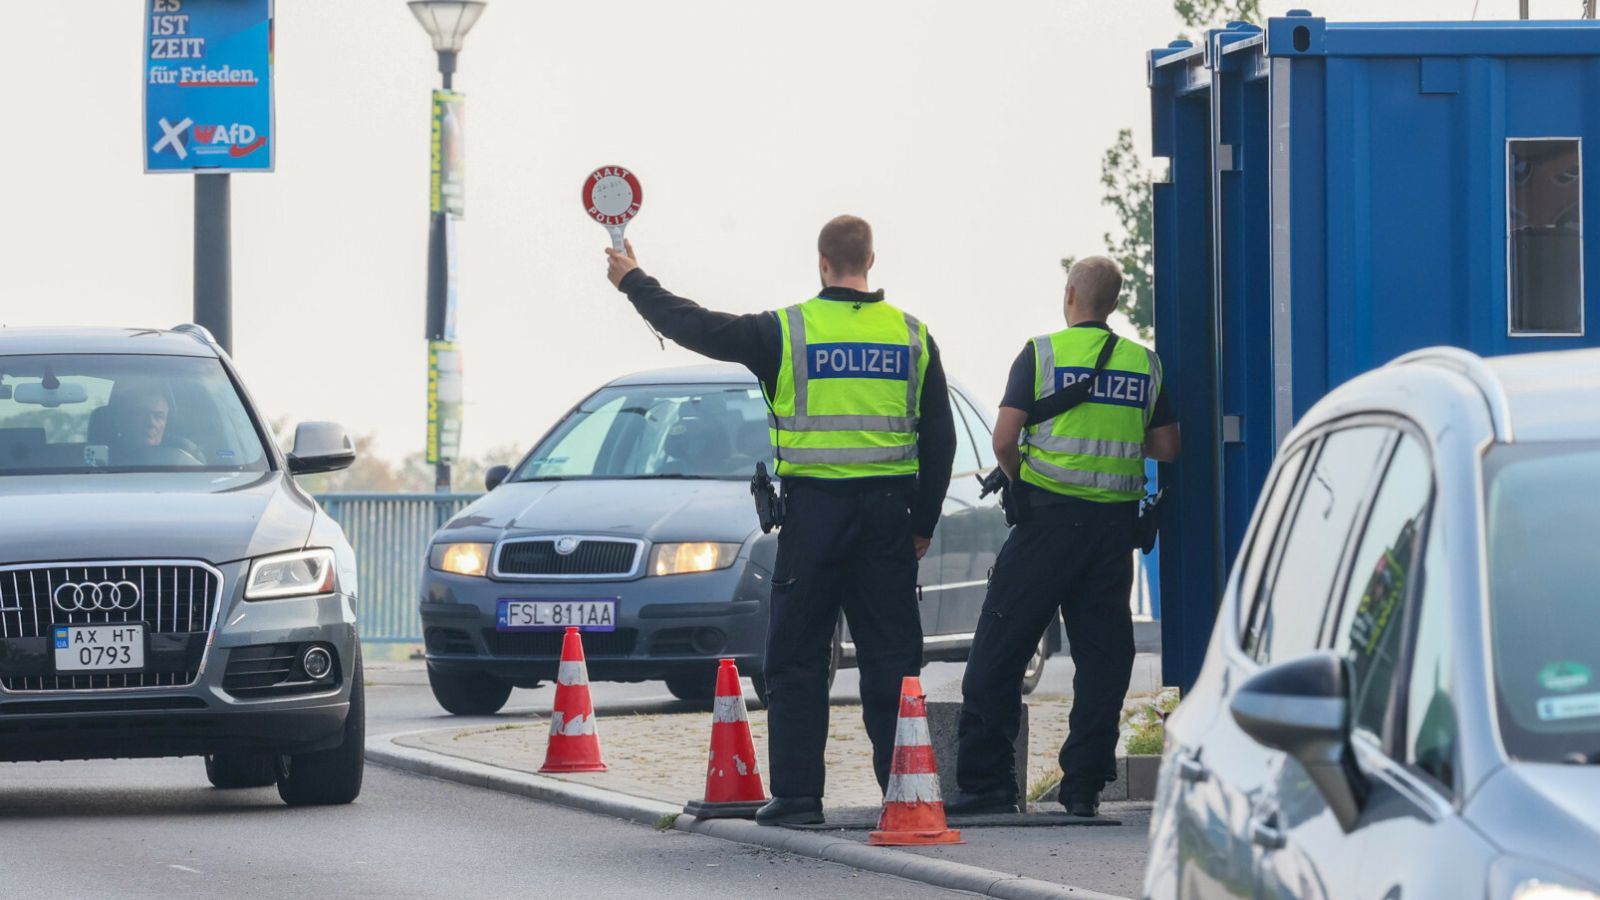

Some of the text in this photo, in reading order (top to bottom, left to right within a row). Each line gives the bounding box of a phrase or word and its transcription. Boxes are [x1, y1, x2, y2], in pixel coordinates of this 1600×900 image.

[152, 0, 181, 12] ES
[152, 15, 189, 36] IST
[151, 38, 205, 59] ZEIT
[150, 65, 259, 83] für Frieden.
[212, 123, 255, 144] AfD
[593, 168, 629, 180] HALT
[588, 202, 640, 224] POLIZEI
[815, 348, 901, 374] POLIZEI
[509, 603, 612, 625] FSL 811AA
[74, 628, 136, 643] AX HT
[79, 646, 131, 665] 0793
